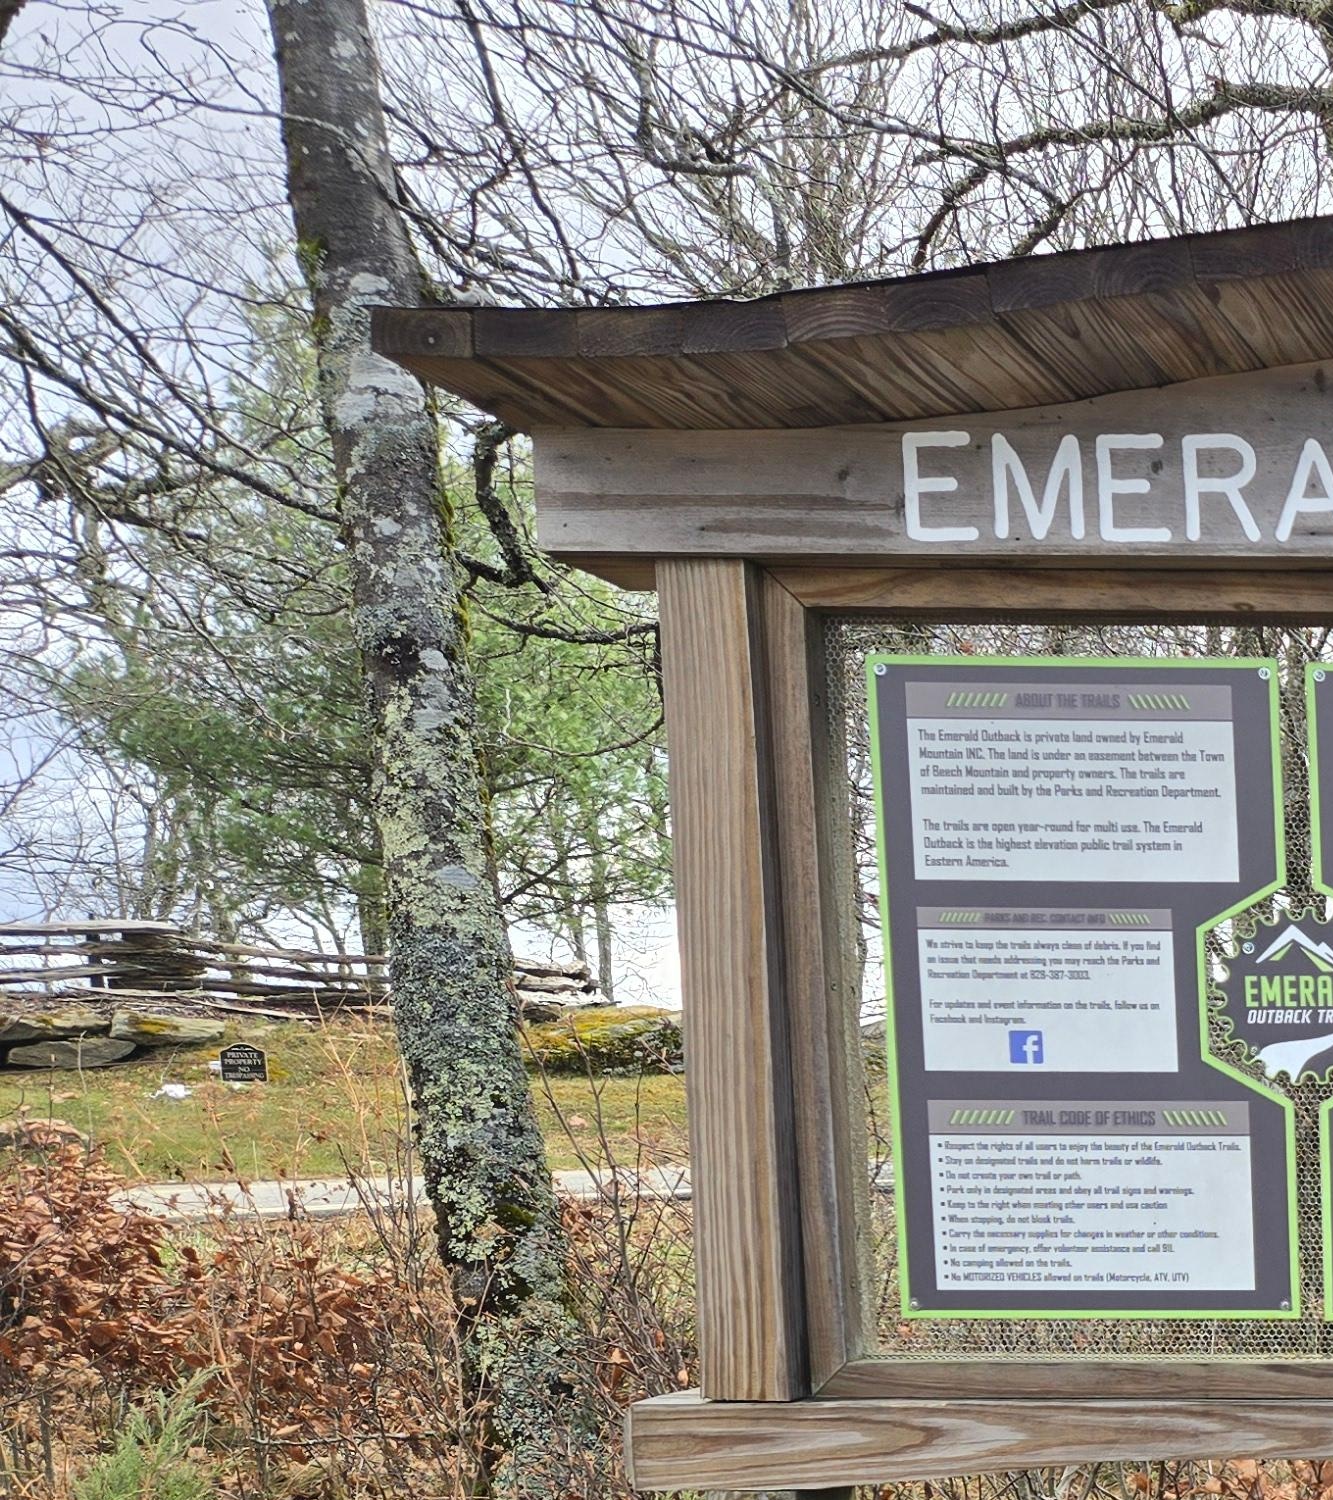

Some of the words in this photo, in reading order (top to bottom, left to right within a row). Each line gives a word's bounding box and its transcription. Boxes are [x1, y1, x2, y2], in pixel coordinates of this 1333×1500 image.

[1014, 692, 1052, 708] ABOUT
[1056, 693, 1077, 709] THE
[1080, 693, 1120, 709] TRAILS
[918, 728, 936, 740] The
[937, 728, 979, 741] Emerald
[980, 729, 1021, 741] Outback
[1023, 731, 1032, 742] is
[1034, 731, 1070, 744] private
[1072, 730, 1093, 742] land
[1095, 731, 1127, 742] owned
[1128, 731, 1140, 745] by
[1143, 731, 1184, 743] Emerald
[918, 746, 963, 759] Mountain
[988, 747, 1005, 759] The
[1007, 747, 1029, 760] land
[1030, 749, 1040, 760] is
[1042, 748, 1071, 760] under
[1087, 751, 1135, 761] easement
[1137, 749, 1179, 761] between
[1180, 749, 1197, 761] the
[1200, 749, 1224, 761] Town
[919, 764, 930, 776] of
[931, 764, 962, 777] Beech
[964, 765, 1009, 777] Mountain
[1011, 766, 1030, 778] and
[1031, 768, 1075, 780] property
[1119, 766, 1137, 778] The
[1139, 767, 1166, 779] trails
[1168, 771, 1185, 779] are
[920, 783, 975, 795] maintained
[976, 783, 995, 795] and
[996, 783, 1019, 796] built
[1020, 783, 1033, 798] by
[1035, 784, 1052, 796] the
[1054, 783, 1083, 796] Parks
[1085, 784, 1103, 796] and
[1105, 784, 1159, 797] Recreation
[923, 818, 940, 830] The
[942, 819, 969, 831] trails
[972, 823, 989, 831] are
[991, 823, 1015, 833] open
[1017, 820, 1074, 834] year-round
[1075, 820, 1090, 832] for
[1093, 820, 1118, 832] multi
[1143, 820, 1160, 832] The
[1162, 820, 1203, 833] Emerald
[923, 836, 963, 848] Outback
[965, 837, 975, 849] is
[976, 837, 993, 849] the
[995, 837, 1031, 852] highest
[1033, 838, 1078, 849] elevation
[1080, 838, 1110, 852] public
[1111, 838, 1133, 850] trail
[1135, 840, 1171, 852] system
[1173, 839, 1182, 850] in
[1247, 1009, 1312, 1024] OUTBACK
[1022, 1110, 1054, 1126] TRAIL
[1058, 1110, 1091, 1126] CODE
[1094, 1110, 1110, 1126] OF
[1112, 1110, 1156, 1126] ETHICS
